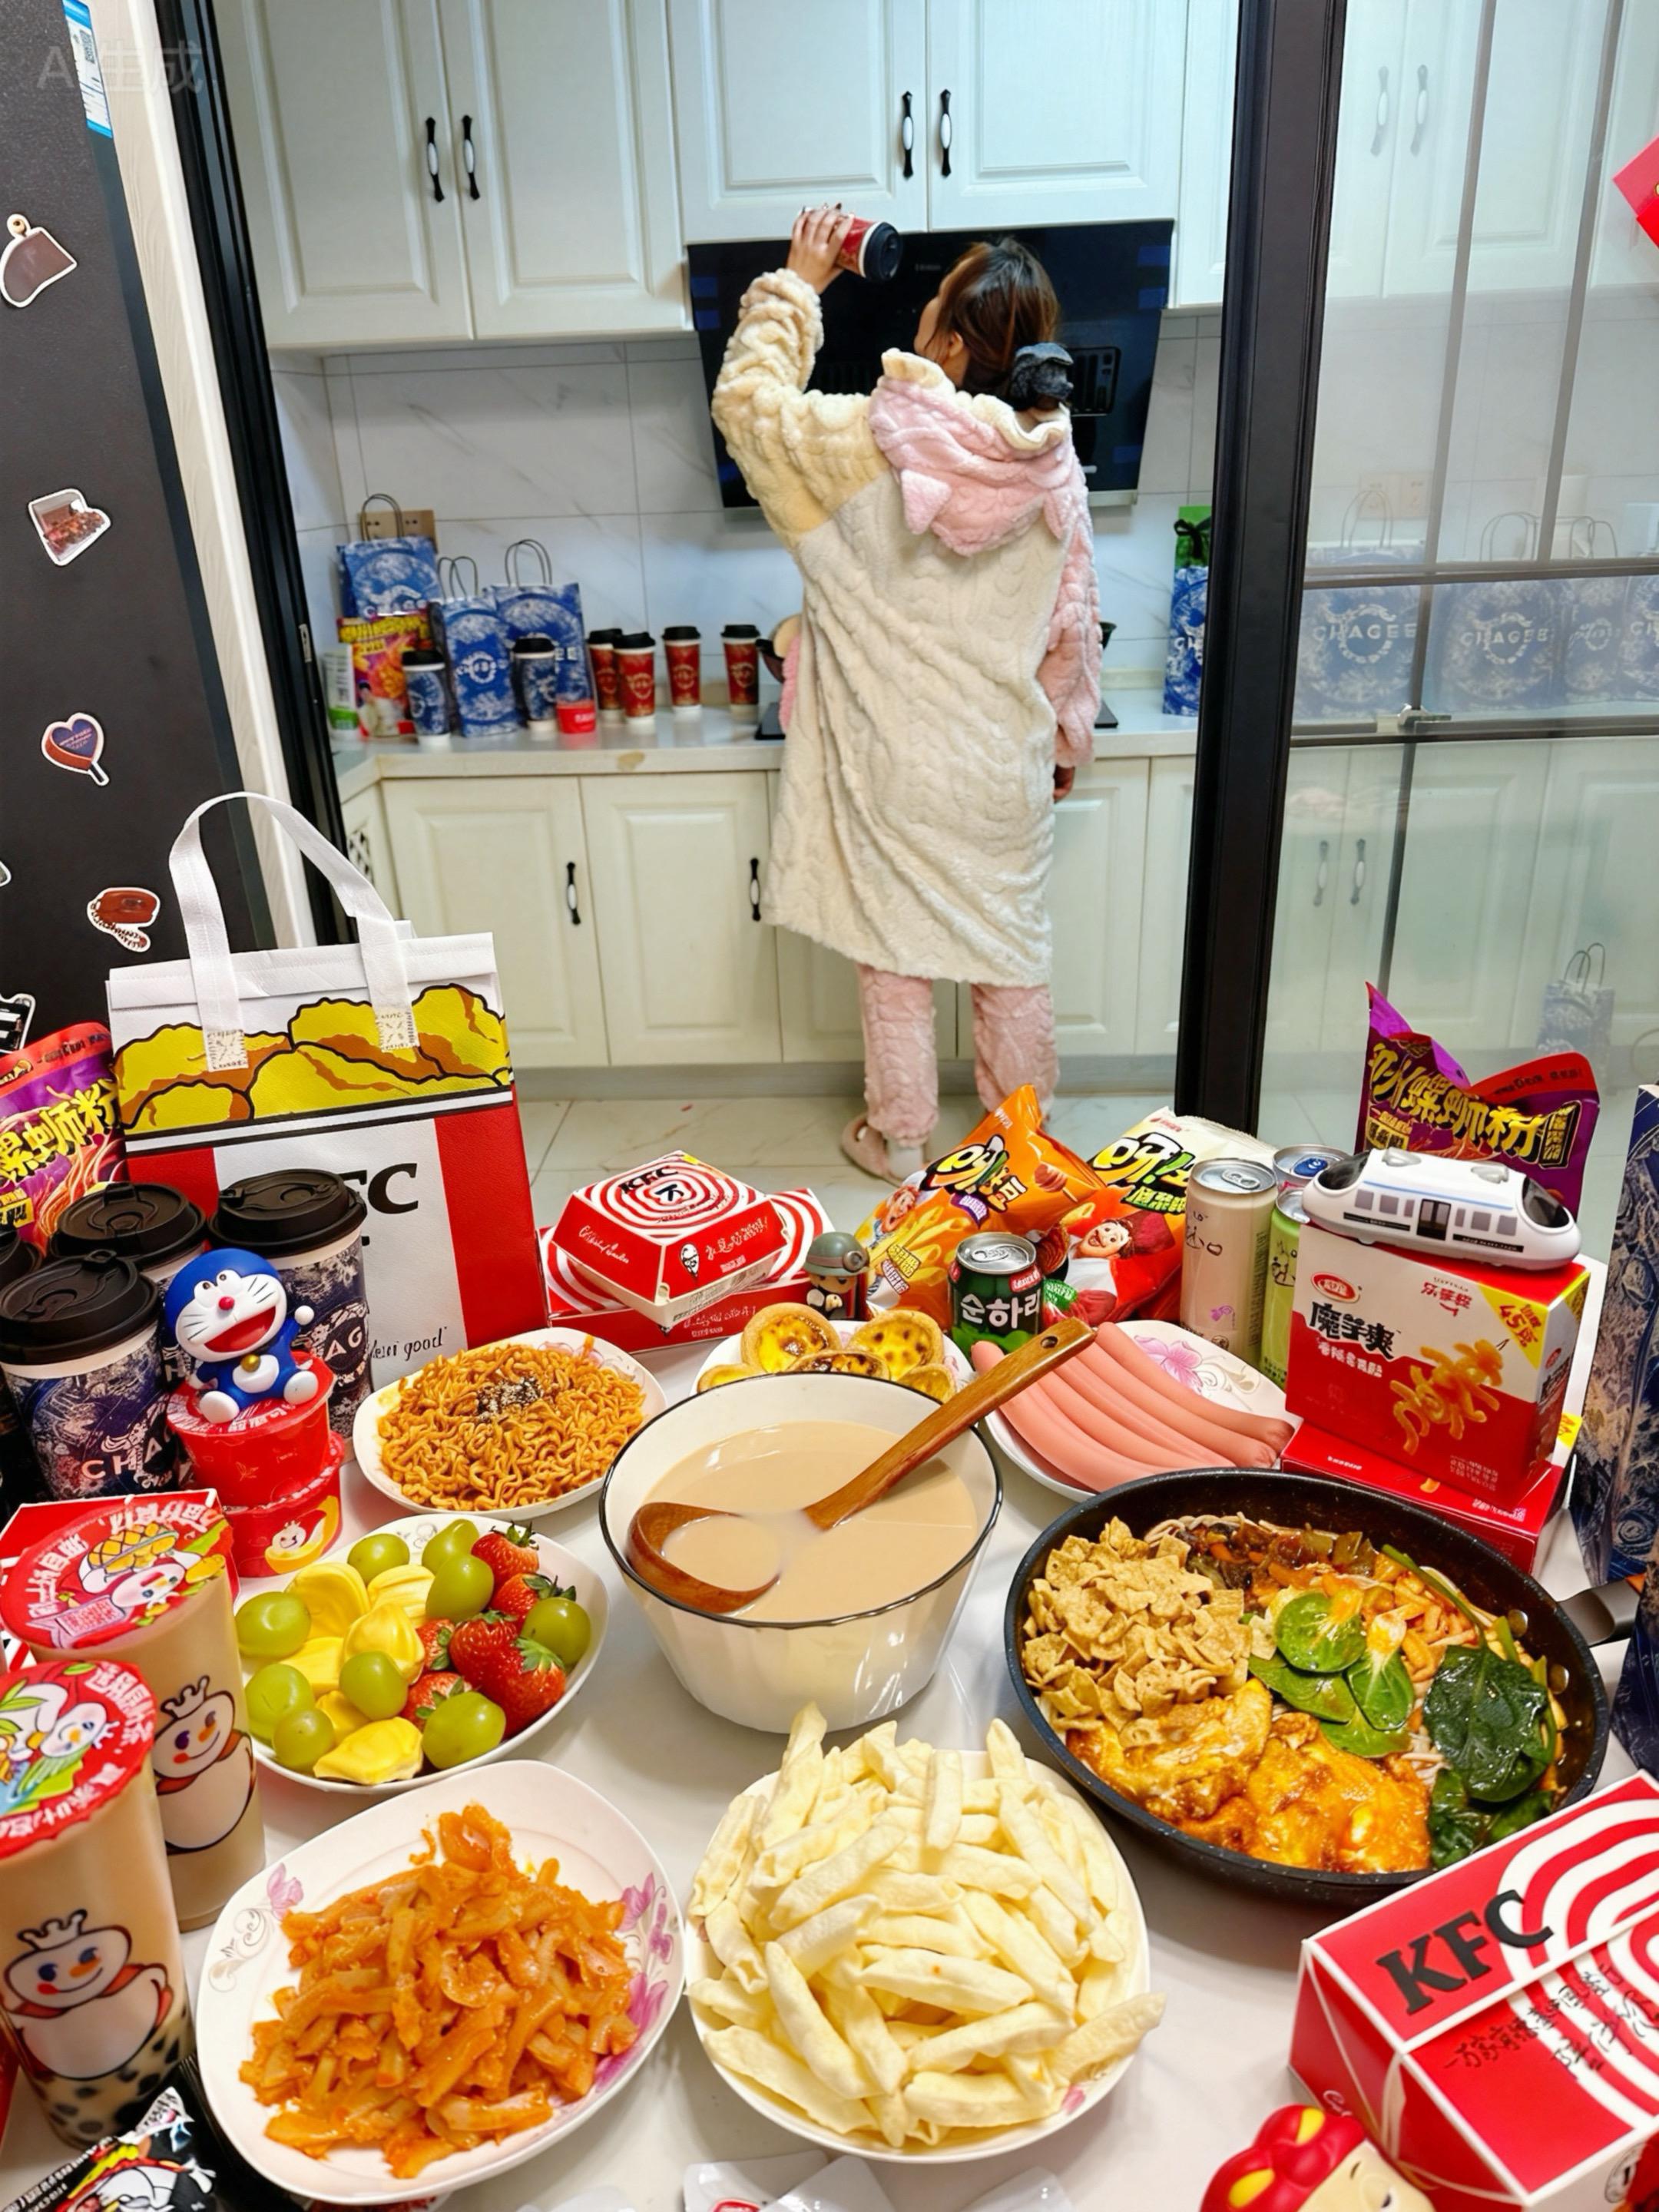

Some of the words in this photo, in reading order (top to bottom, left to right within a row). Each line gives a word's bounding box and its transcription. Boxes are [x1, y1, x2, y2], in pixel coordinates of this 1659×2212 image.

[618, 1165, 678, 1194] KFC
[1308, 1301, 1395, 1359] 魔芋爽
[1376, 1889, 1555, 2016] KFC
